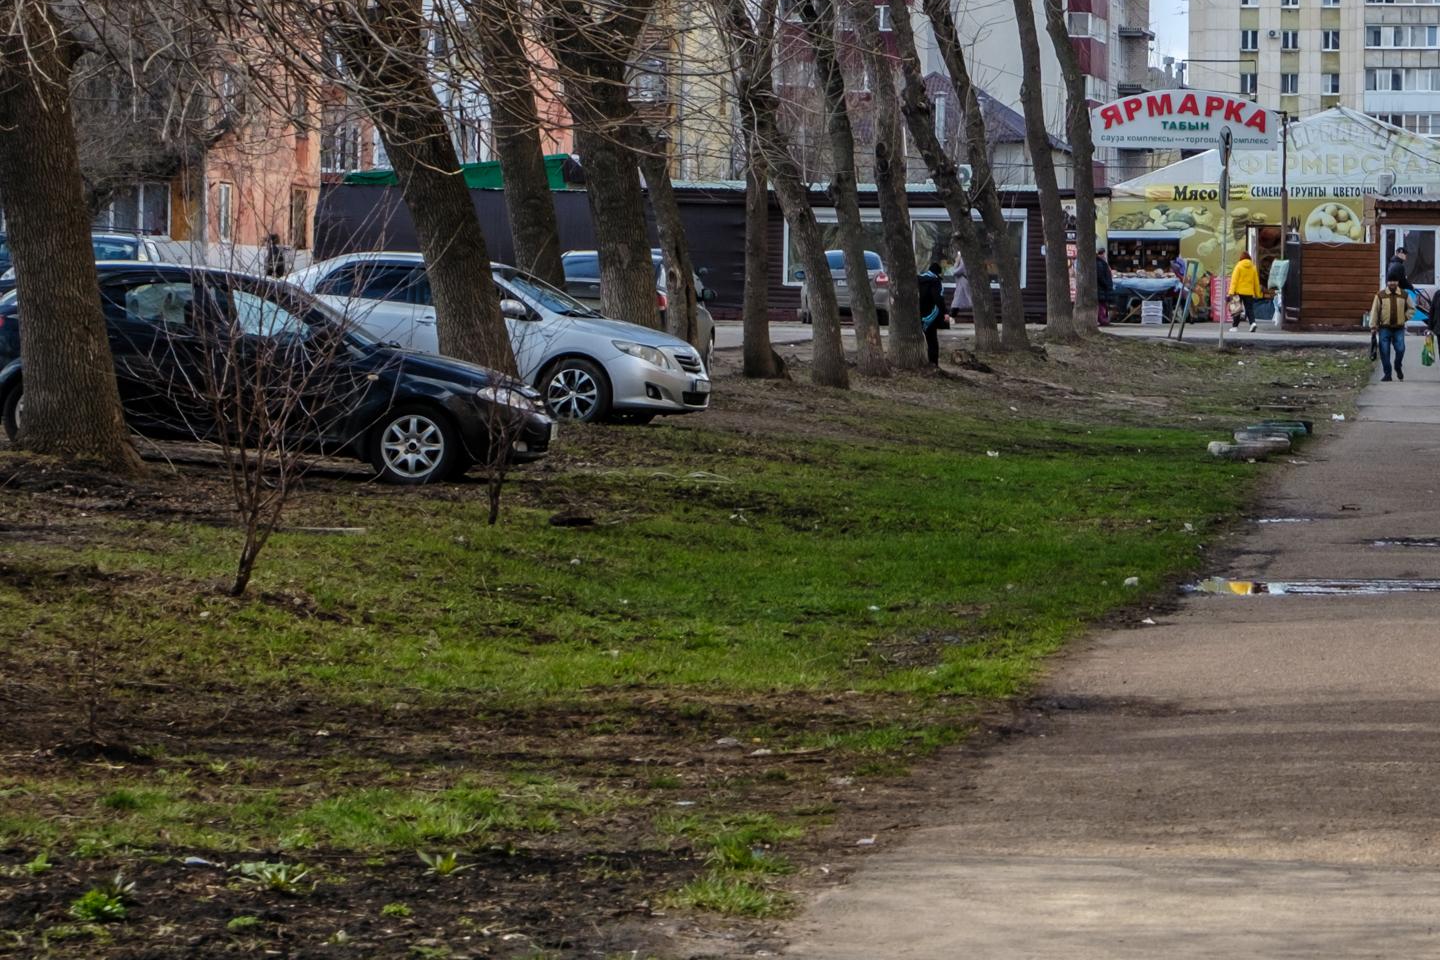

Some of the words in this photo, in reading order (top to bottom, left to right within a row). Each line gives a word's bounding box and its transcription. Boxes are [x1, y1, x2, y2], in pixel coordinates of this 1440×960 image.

[1100, 93, 1267, 134] ЯРМАРКА
[1161, 121, 1210, 131] ТАБЫН
[1127, 135, 1174, 143] комплексы
[1233, 137, 1269, 145] омплекс
[1173, 185, 1218, 201] Мясо
[1291, 186, 1327, 198] ГРУНТЫ
[1392, 186, 1424, 196] ОРШКИ
